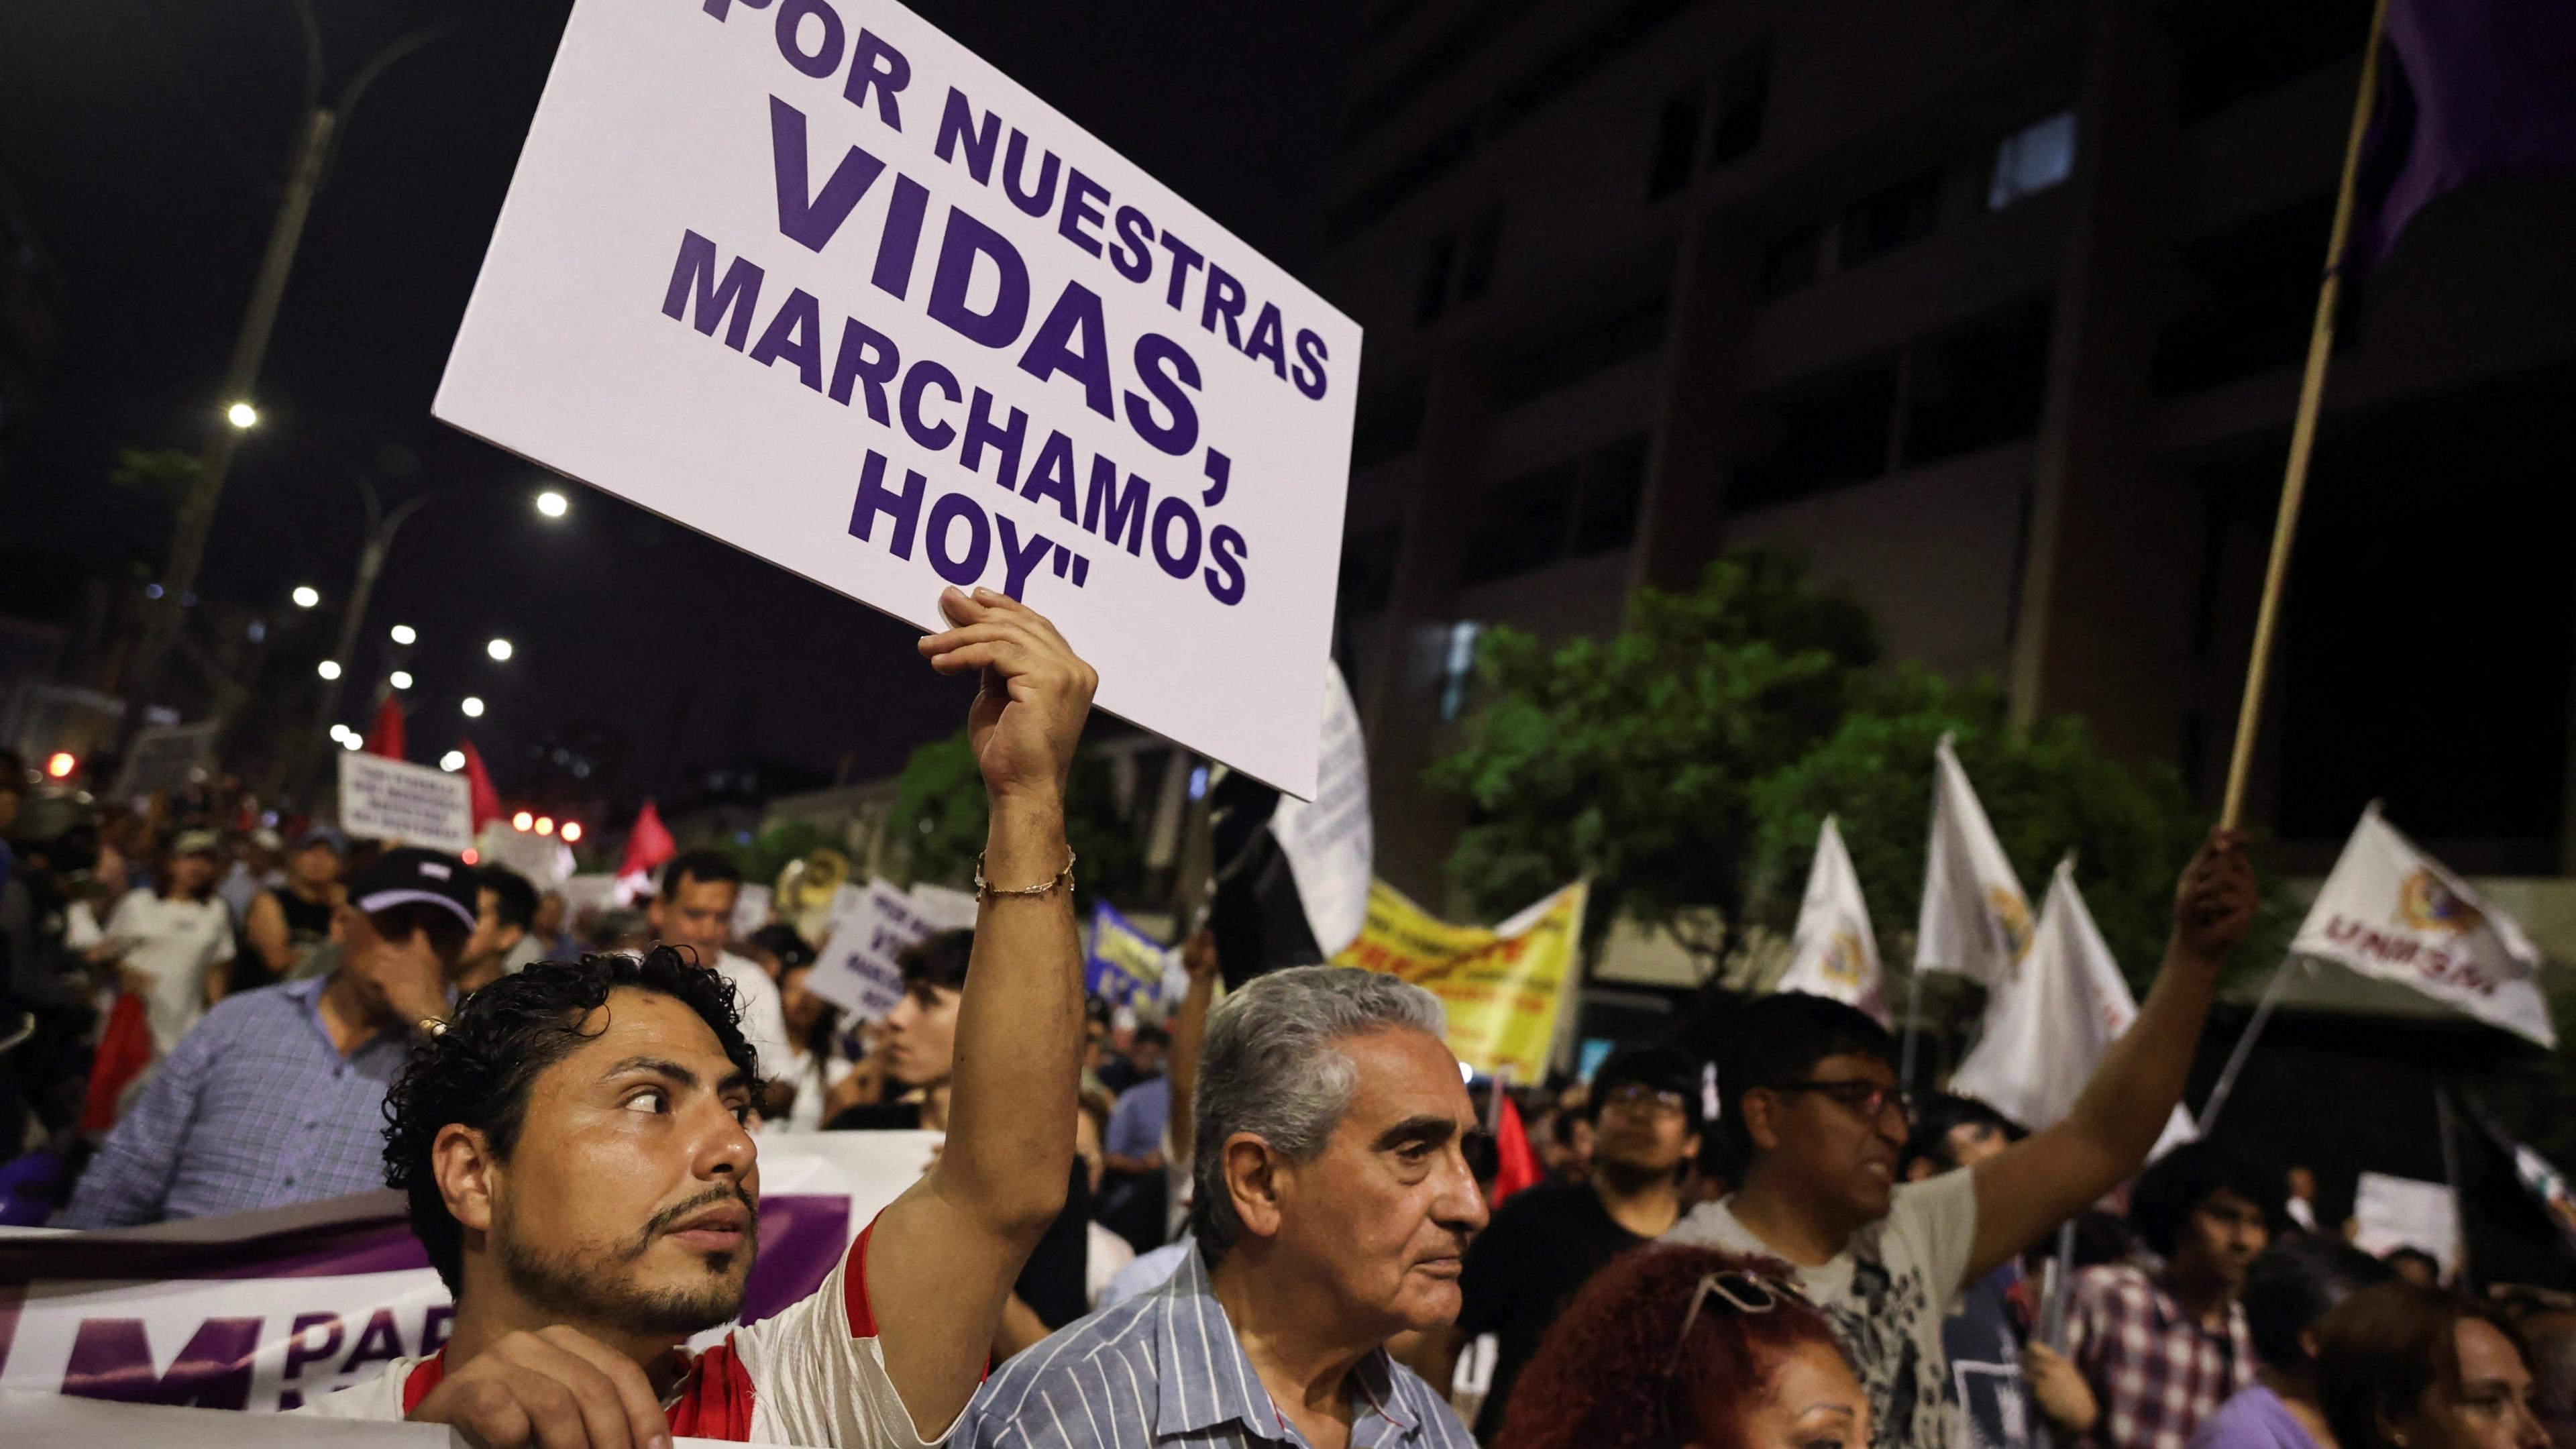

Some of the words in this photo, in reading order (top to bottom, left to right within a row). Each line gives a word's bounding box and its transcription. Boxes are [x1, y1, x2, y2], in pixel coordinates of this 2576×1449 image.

[702, 0, 912, 133] OR
[934, 86, 1328, 401] NUESTRAS
[769, 94, 1231, 508] VIDAS,
[662, 229, 1248, 606] MARCHAMOS
[847, 449, 1090, 602] HOY"
